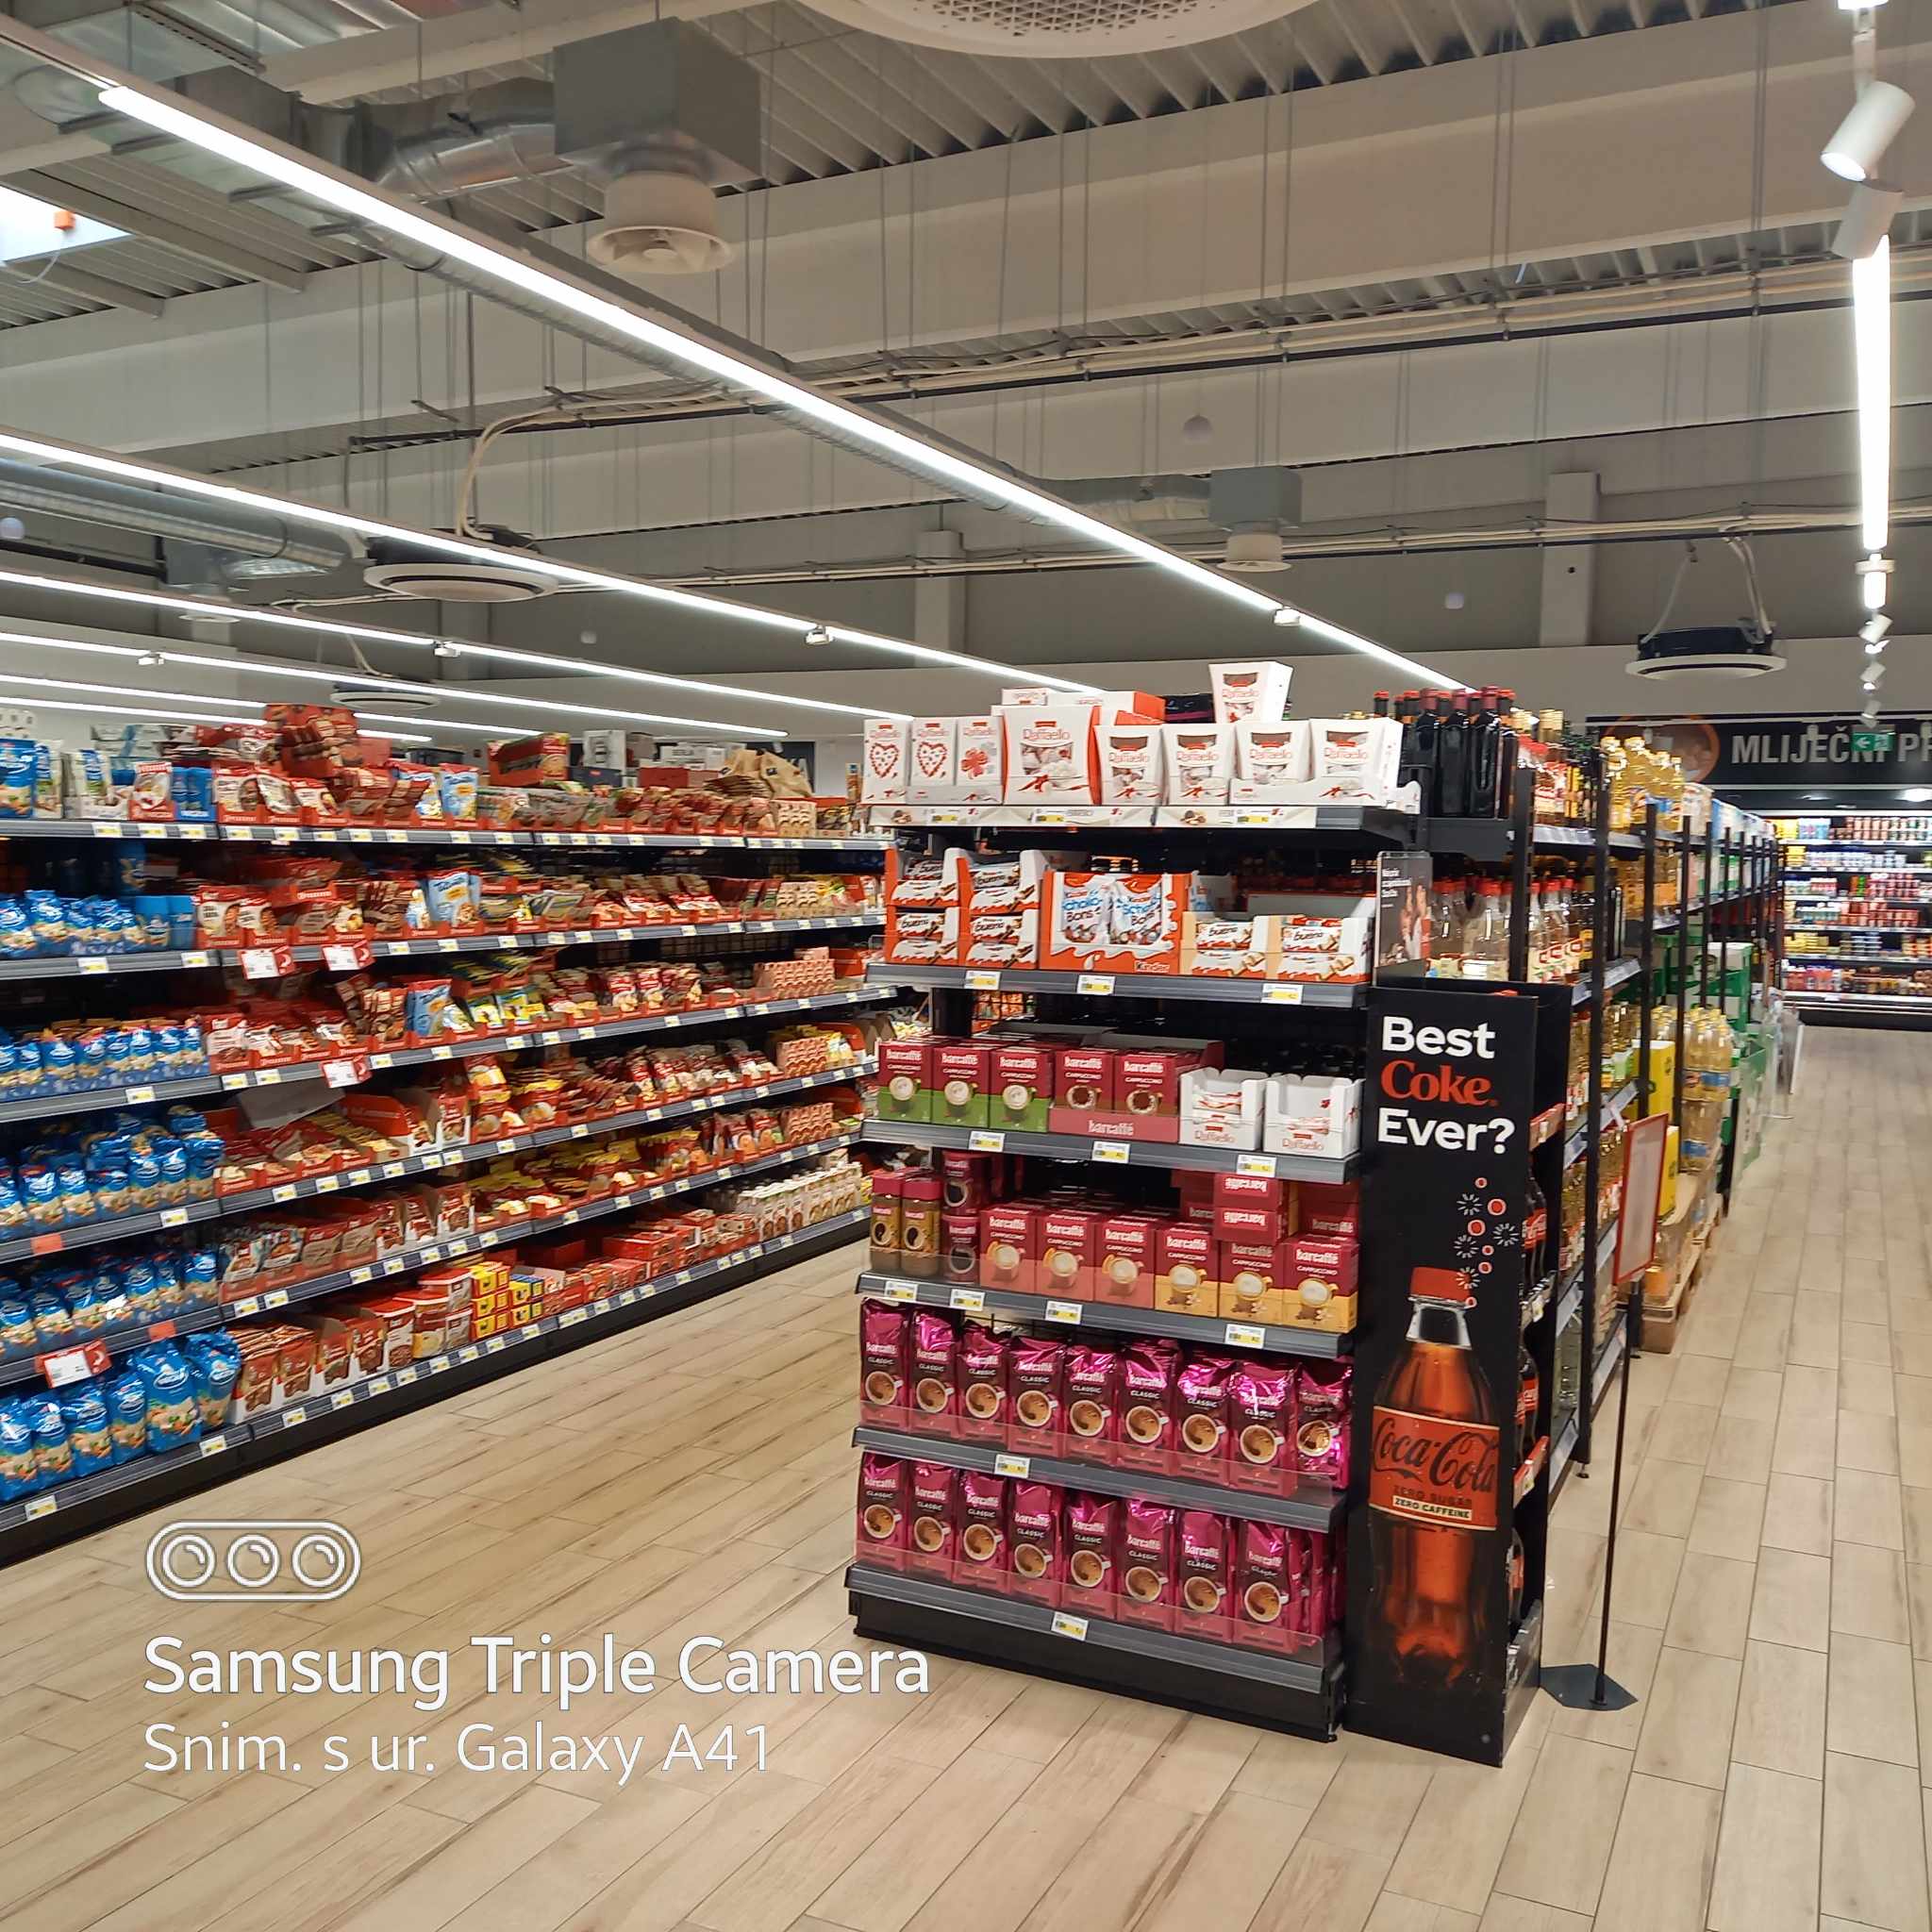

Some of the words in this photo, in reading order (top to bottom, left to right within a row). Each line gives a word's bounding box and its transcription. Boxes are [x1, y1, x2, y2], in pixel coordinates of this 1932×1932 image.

[1382, 1016, 1495, 1058] Best
[1380, 1059, 1492, 1106] Coke
[1378, 1108, 1515, 1155] Ever?
[867, 1357, 894, 1365] CLASSIC
[919, 1363, 944, 1372] CLASSIC
[969, 1368, 996, 1376] CLASSIC
[1020, 1375, 1049, 1384] CLASSIC
[1073, 1385, 1102, 1393] CLASSIC
[1131, 1391, 1159, 1399] CLASSIC
[1188, 1398, 1218, 1407] CLASSIC
[1374, 1417, 1498, 1492] Coca-Cola
[917, 1501, 942, 1510] CLASSIC
[1394, 1498, 1419, 1509] ZERO
[1421, 1502, 1470, 1519] CAFFEINE
[968, 1508, 996, 1518] CLASSIC
[1017, 1528, 1044, 1538] CLASSIC
[1074, 1535, 1102, 1544] CLASSIC
[1129, 1550, 1158, 1561] CLASSIC
[1187, 1559, 1217, 1571] CLASSIC
[1251, 1565, 1277, 1576] CLASSIC
